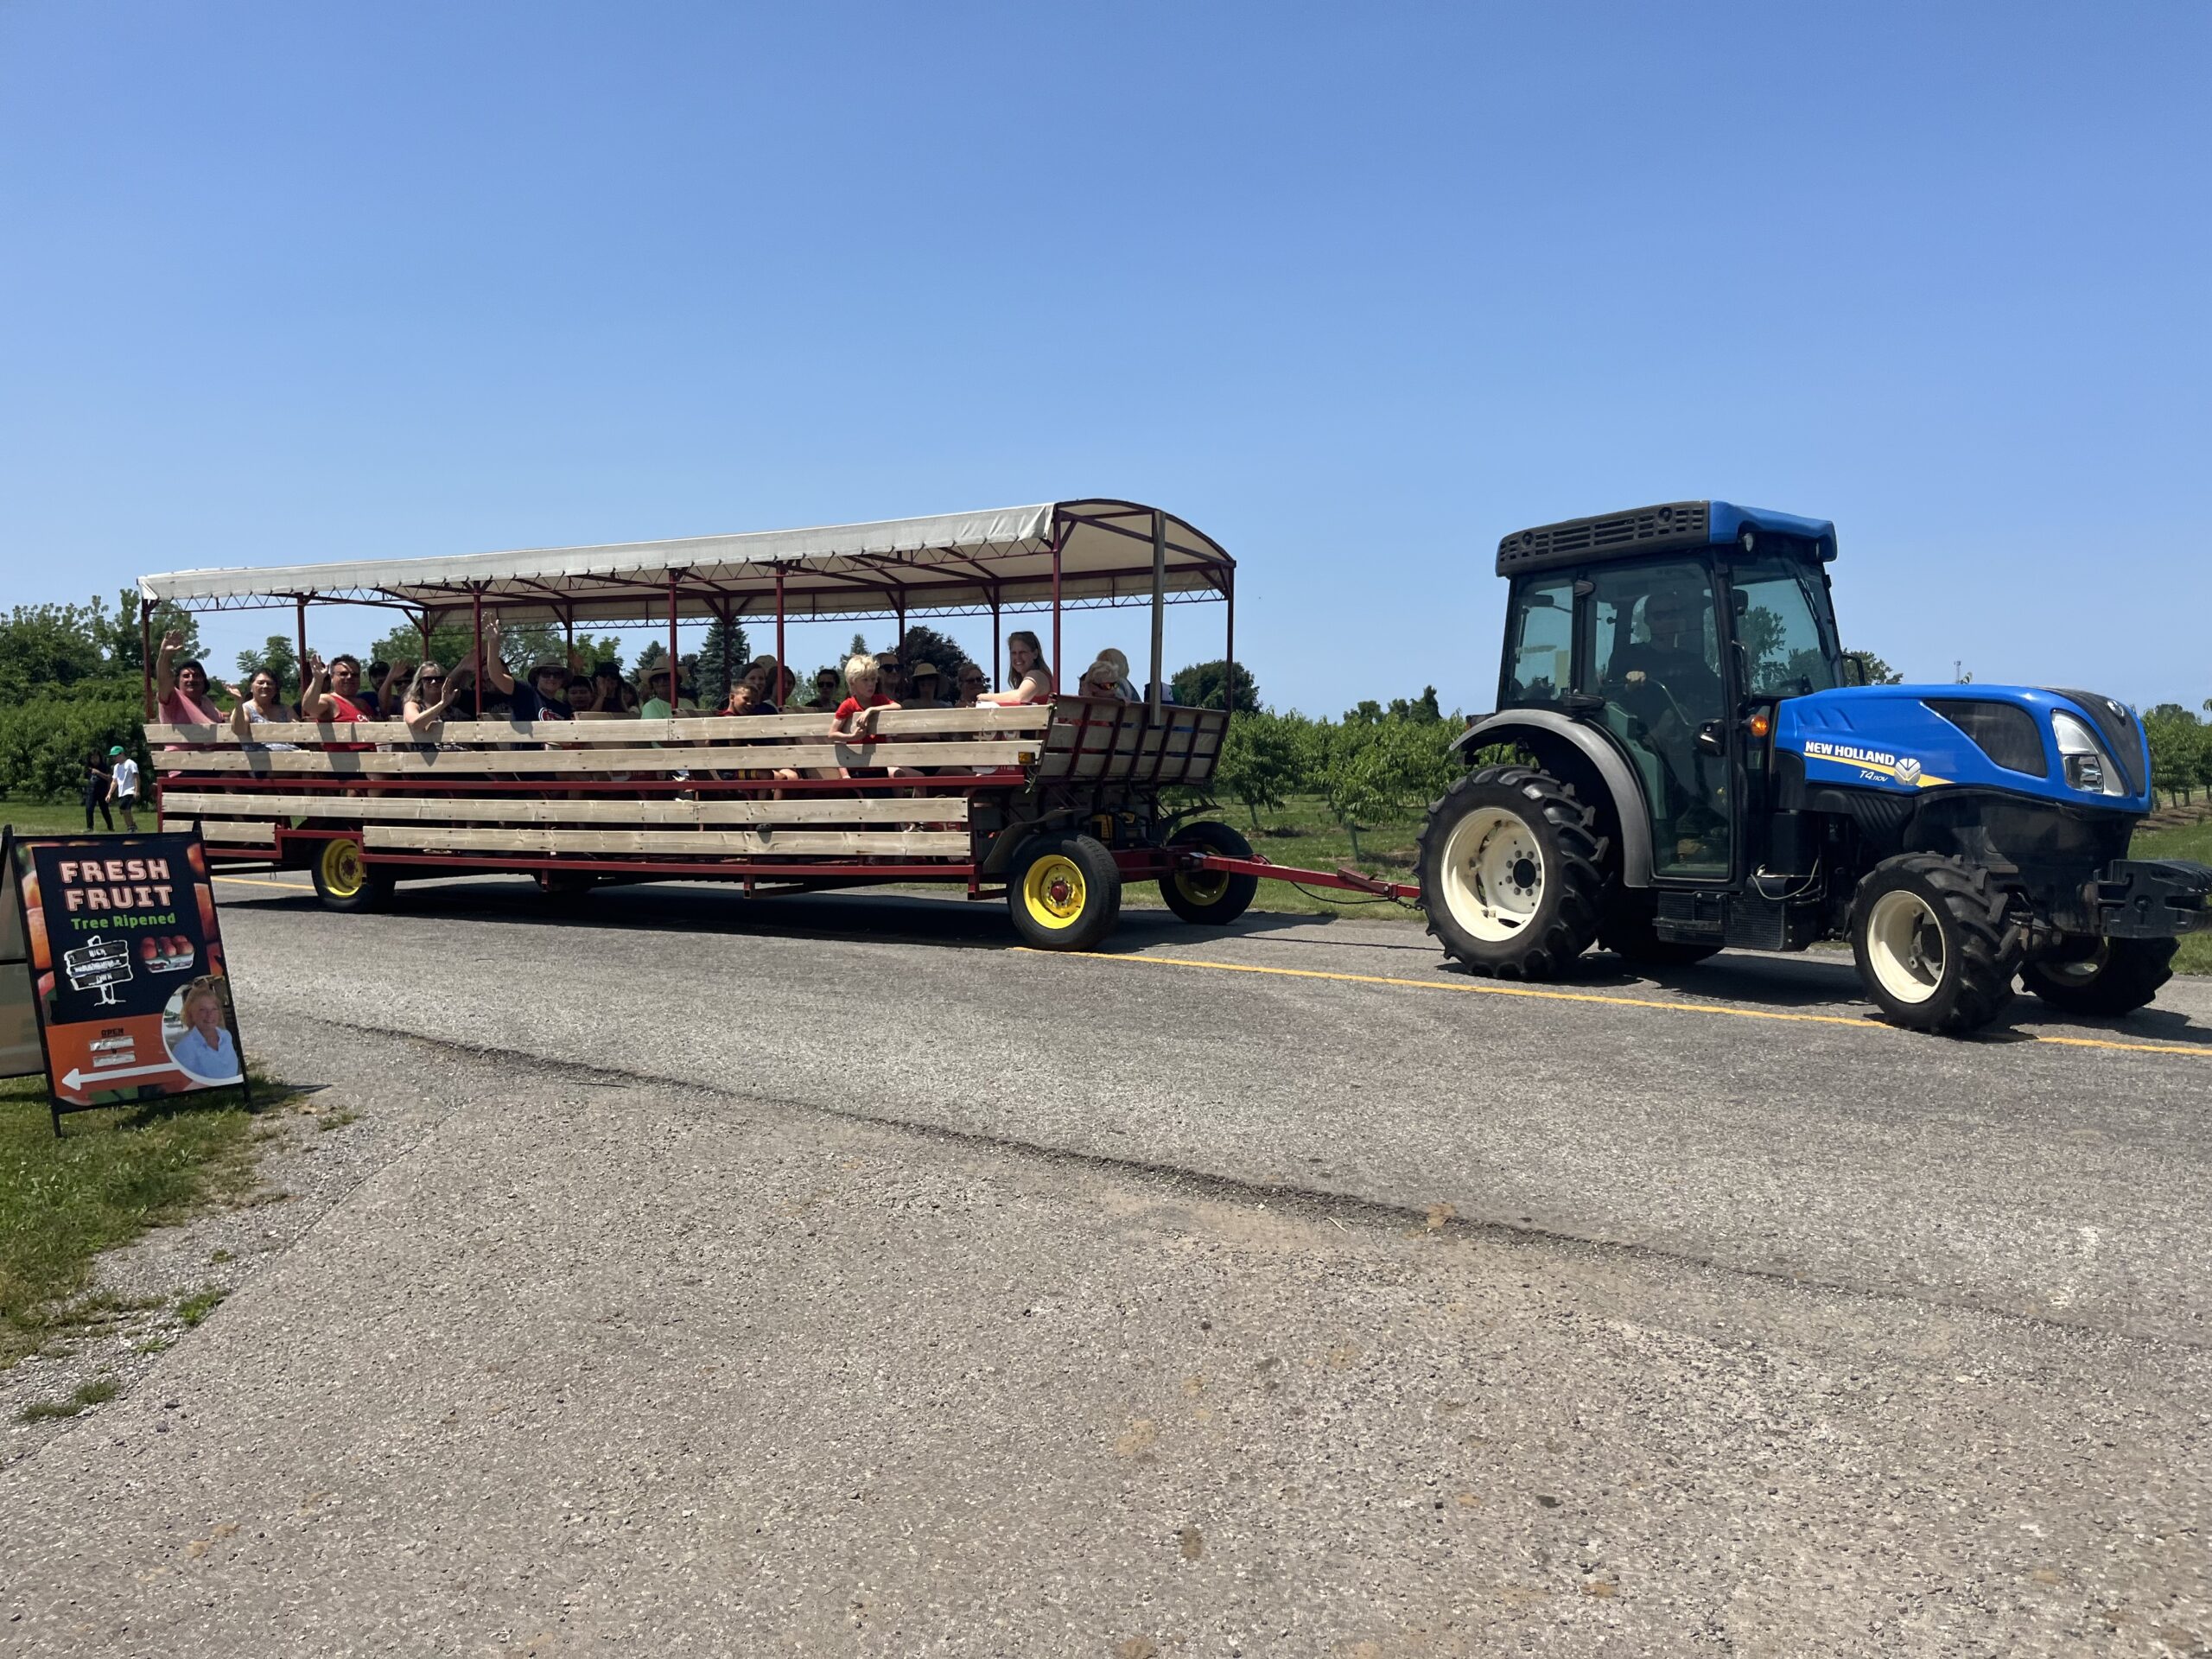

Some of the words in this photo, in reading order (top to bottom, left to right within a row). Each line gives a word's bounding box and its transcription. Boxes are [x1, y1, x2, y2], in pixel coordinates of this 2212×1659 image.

[1805, 741, 1833, 755] NEW
[1834, 745, 1895, 766] HOLLAND
[59, 858, 170, 883] FRESH
[65, 885, 173, 912] FRUIT
[71, 918, 109, 930] Tree
[112, 912, 175, 929] Ripened
